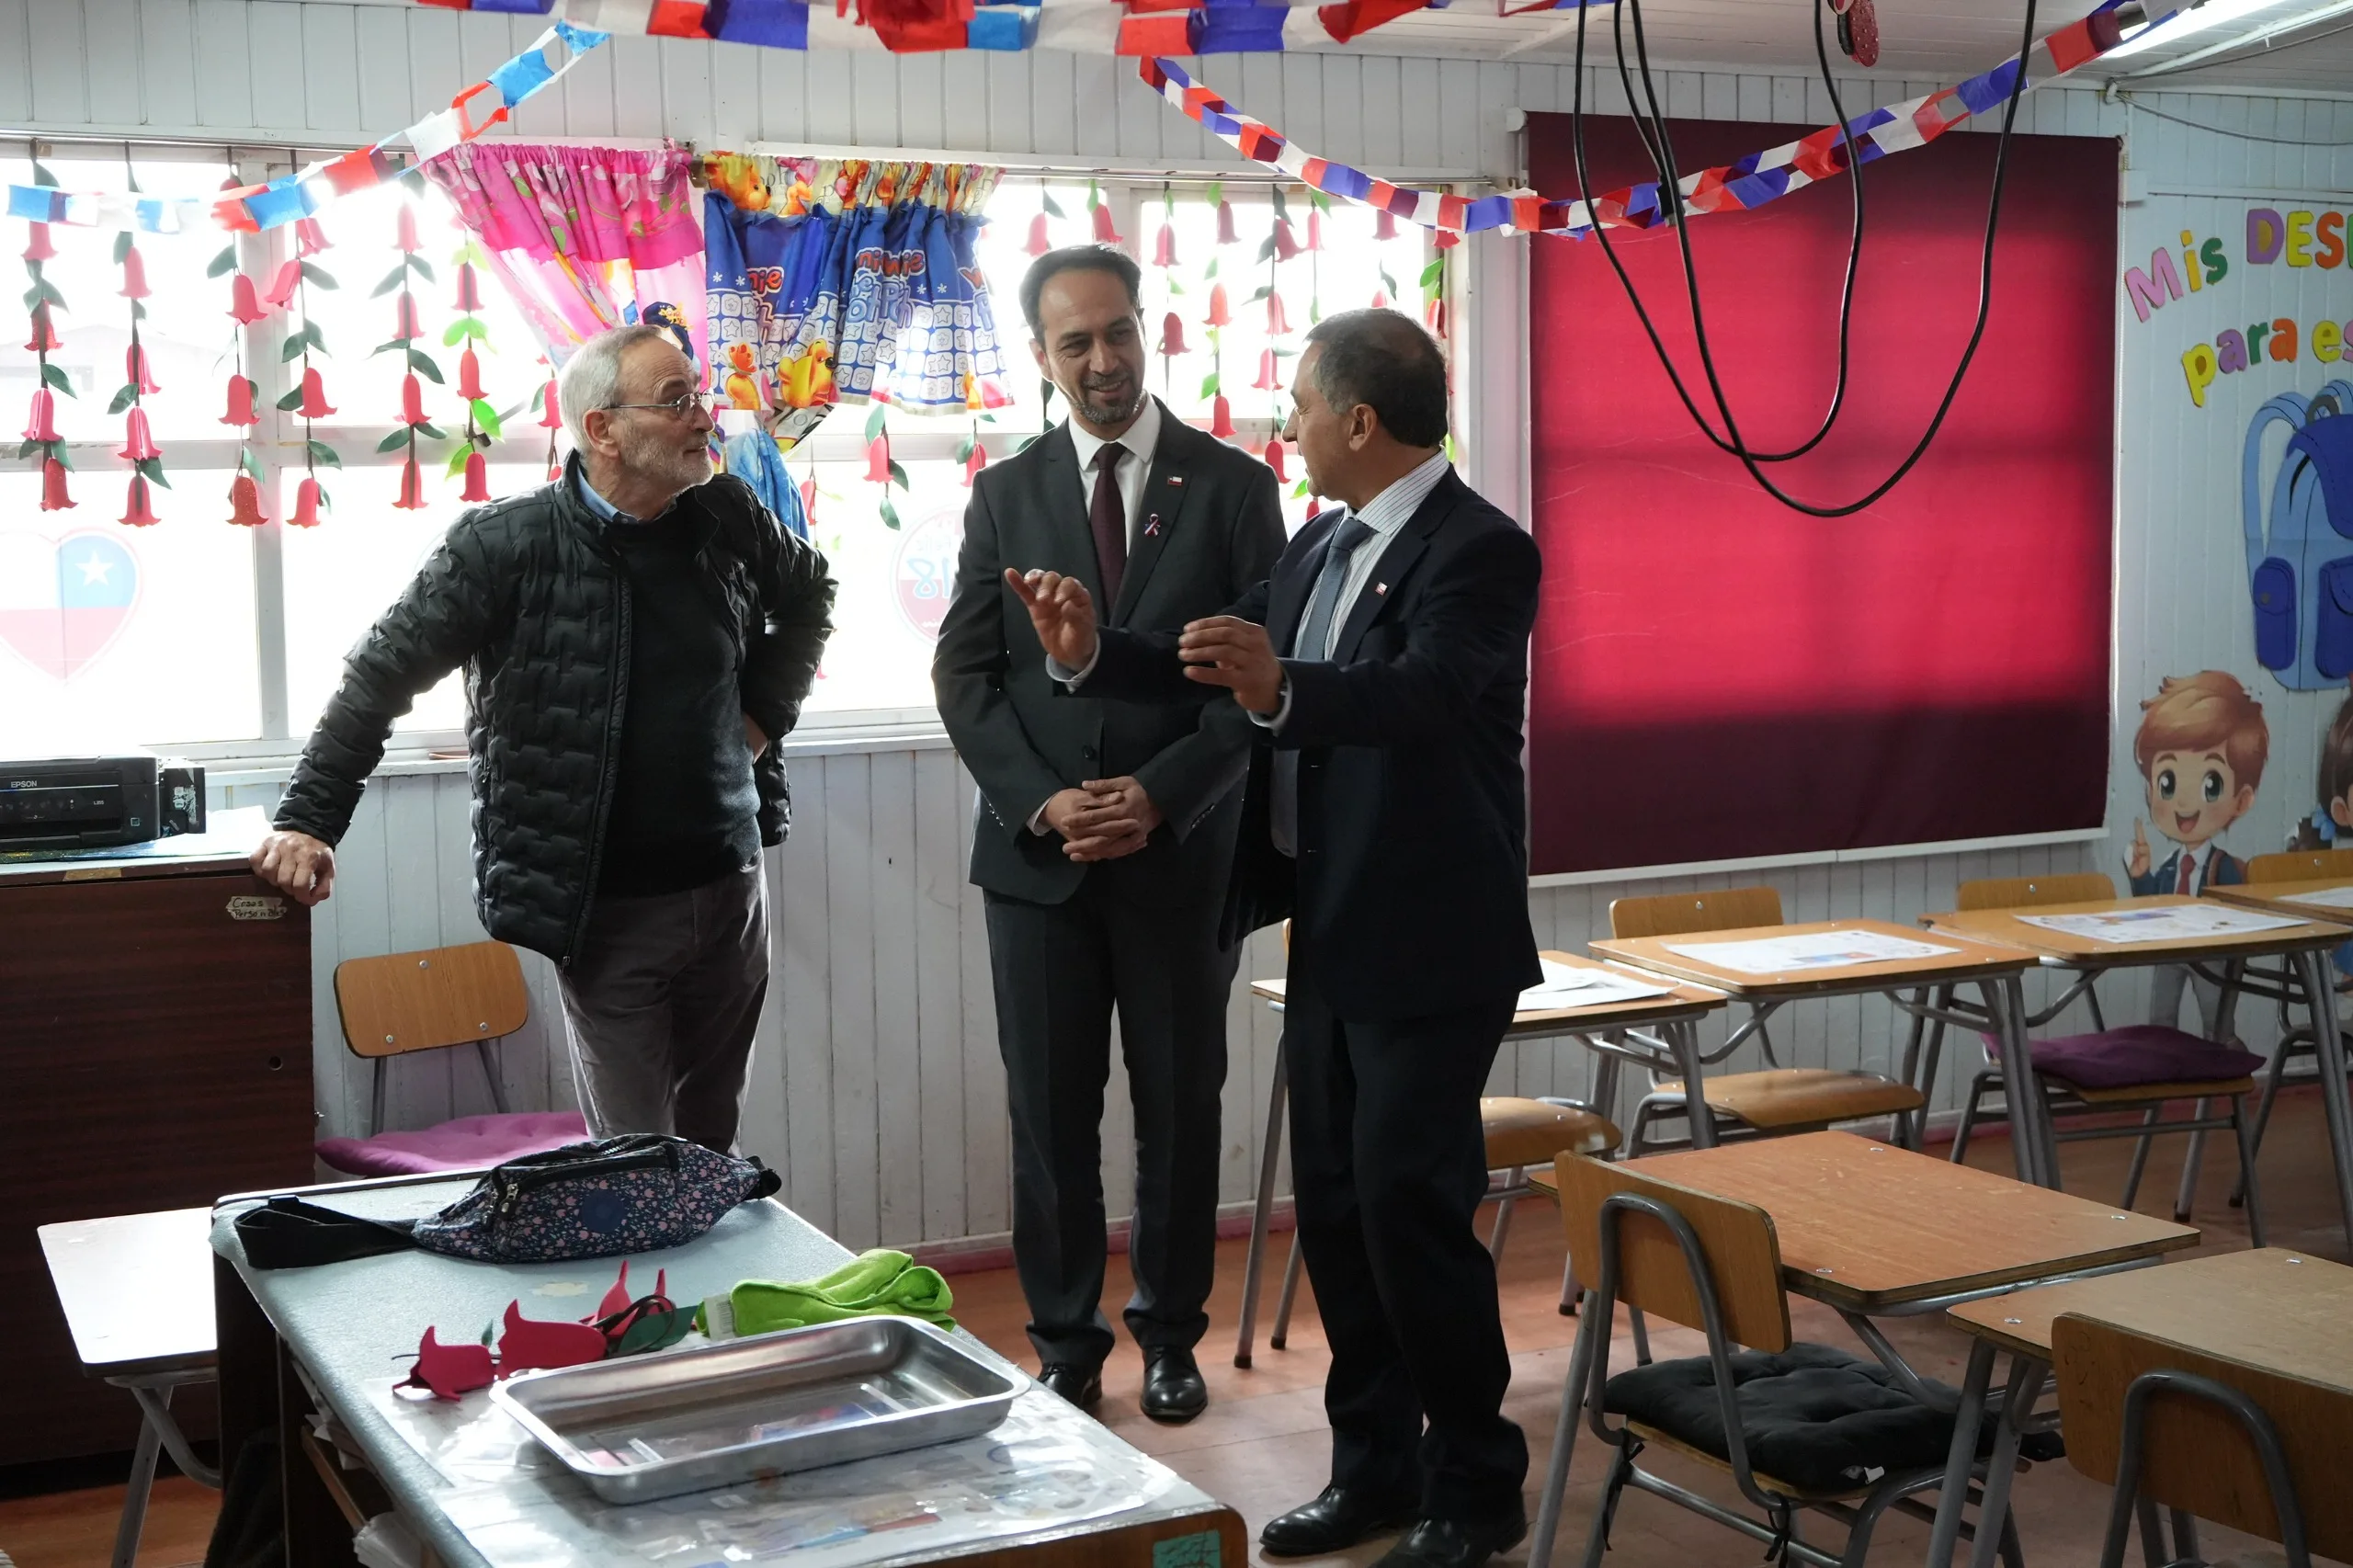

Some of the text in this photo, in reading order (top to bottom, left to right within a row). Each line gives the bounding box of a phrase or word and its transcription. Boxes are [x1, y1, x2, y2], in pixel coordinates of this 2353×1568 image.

[2124, 229, 2228, 323] Mis
[2181, 318, 2298, 408] para
[10, 780, 38, 789] EPSON
